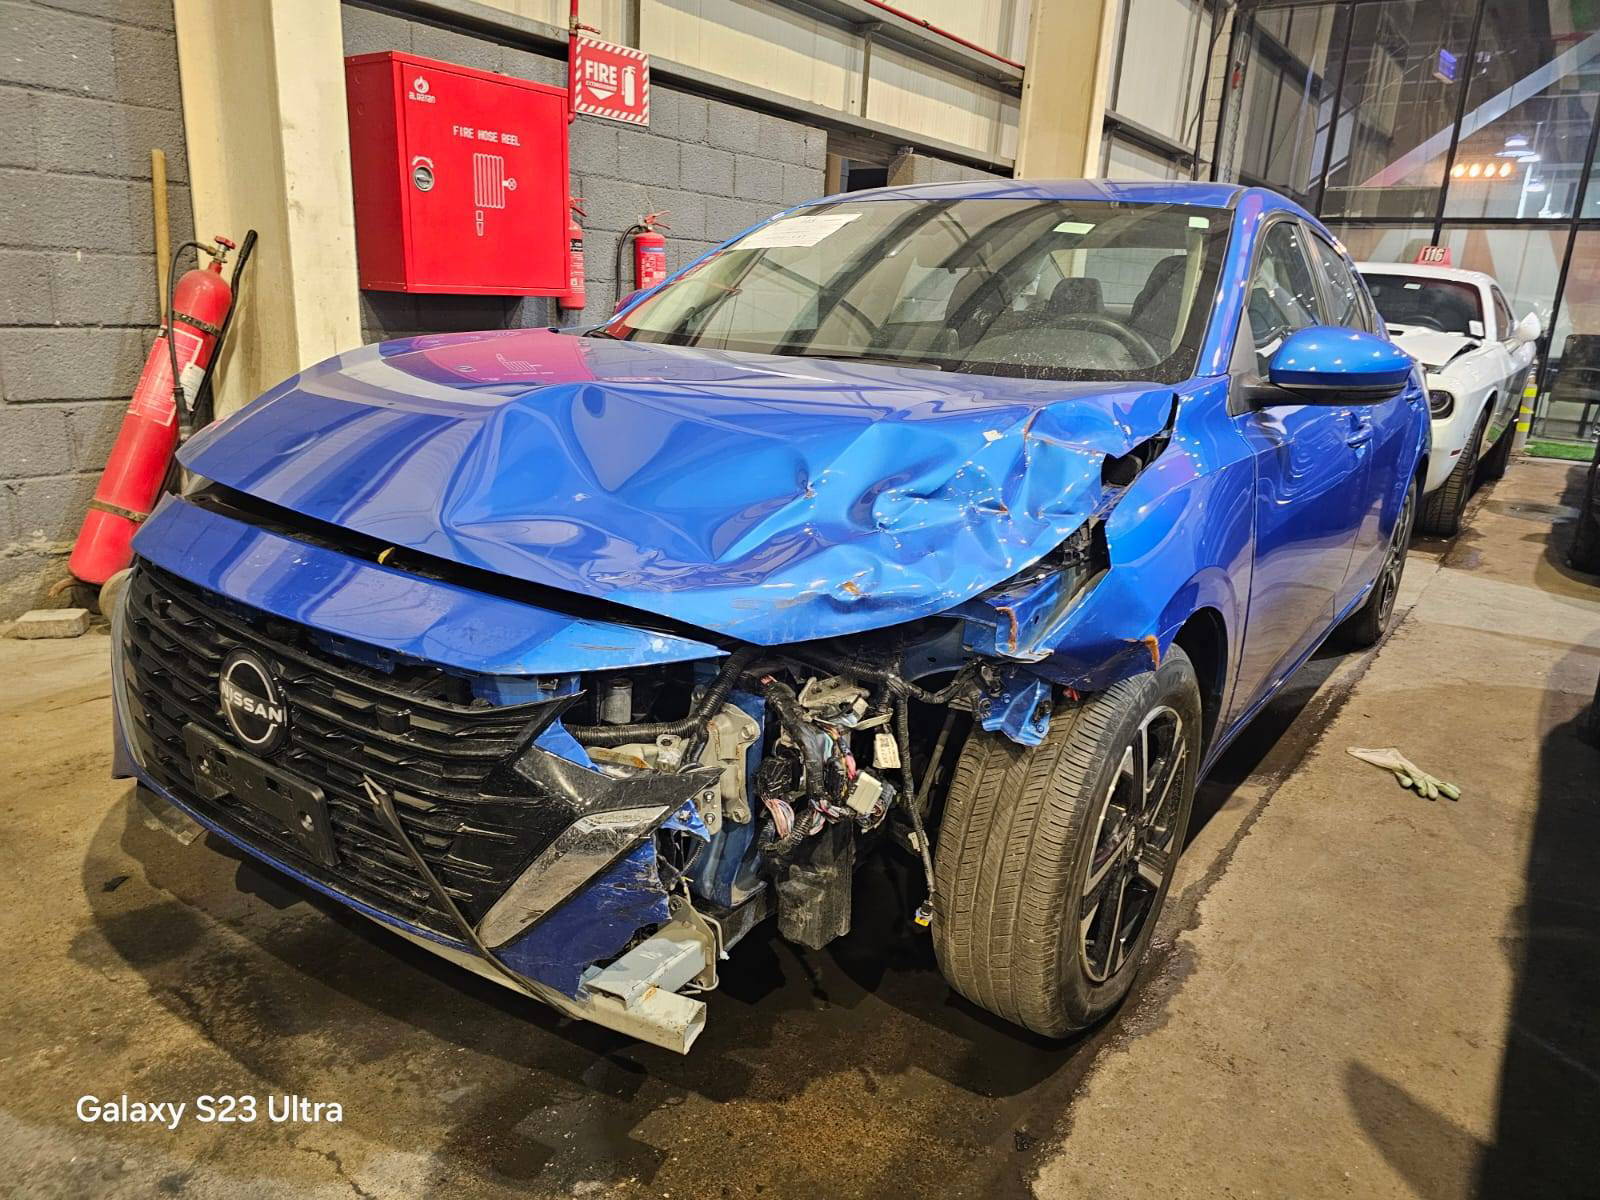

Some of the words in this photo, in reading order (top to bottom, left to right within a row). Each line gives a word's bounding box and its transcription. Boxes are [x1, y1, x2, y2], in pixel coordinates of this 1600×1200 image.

[585, 59, 618, 86] FIRE
[452, 125, 475, 140] FIRE
[477, 129, 499, 143] HOSE
[501, 133, 521, 147] REEL
[1424, 248, 1445, 262] 116
[222, 681, 283, 723] NISSAN
